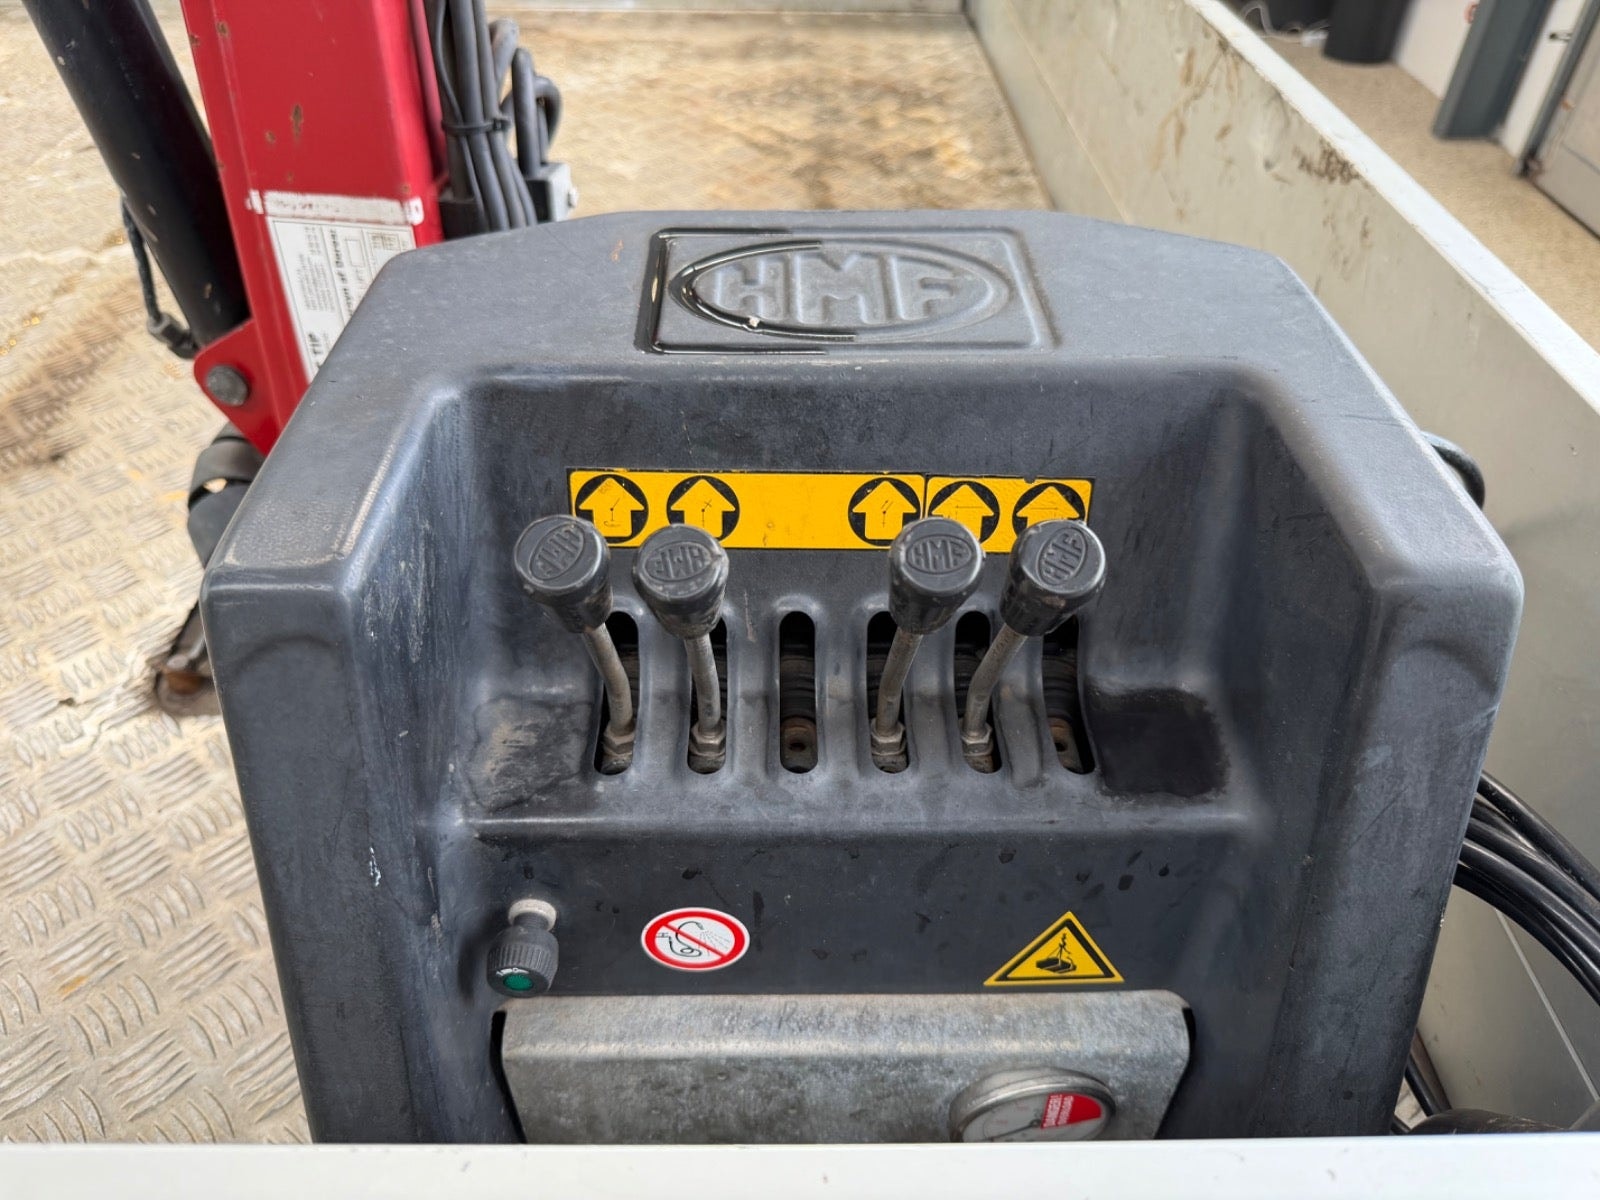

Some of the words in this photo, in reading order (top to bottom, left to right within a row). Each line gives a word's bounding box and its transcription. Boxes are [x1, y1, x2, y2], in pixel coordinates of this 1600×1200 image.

[712, 251, 960, 325] HMF
[536, 525, 582, 579] HMF
[651, 543, 710, 580] HMF
[912, 538, 967, 574] HMF
[1043, 530, 1084, 582] HMF
